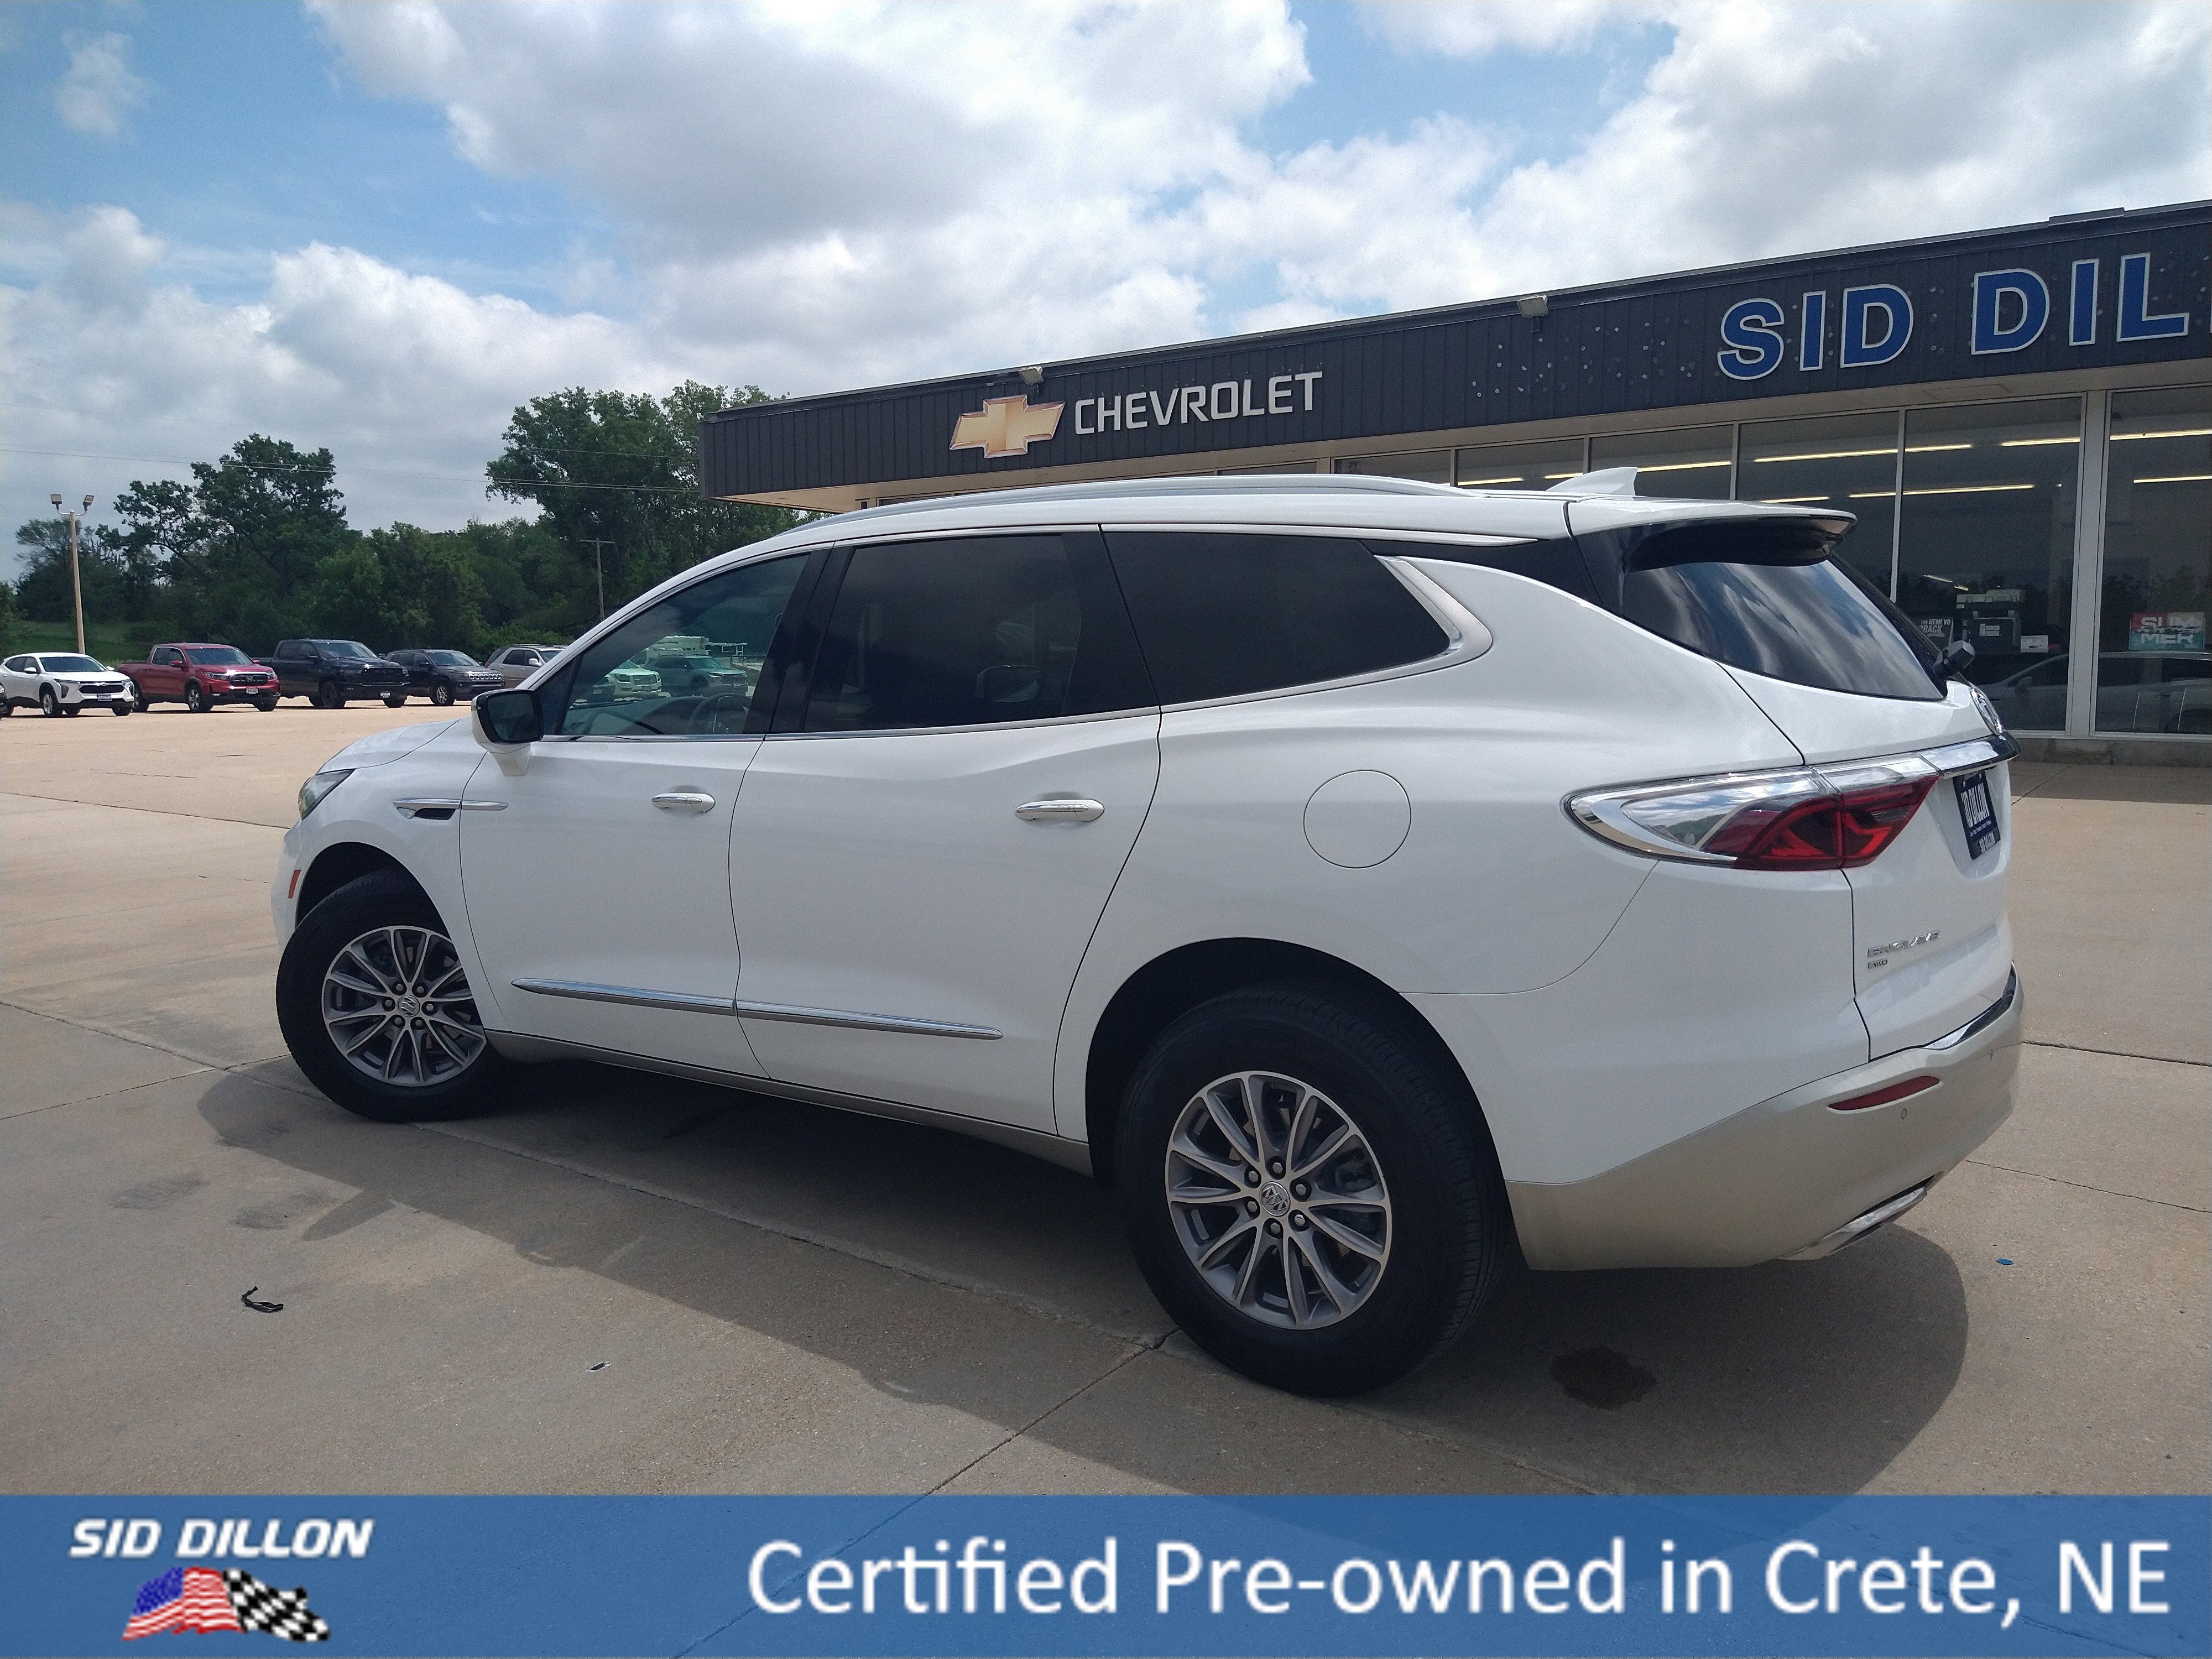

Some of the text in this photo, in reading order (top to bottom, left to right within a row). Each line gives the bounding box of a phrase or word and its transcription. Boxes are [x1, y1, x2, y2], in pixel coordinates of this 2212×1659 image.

[1717, 252, 2212, 380] SID DIL
[1074, 371, 1323, 435] CHEVROLET
